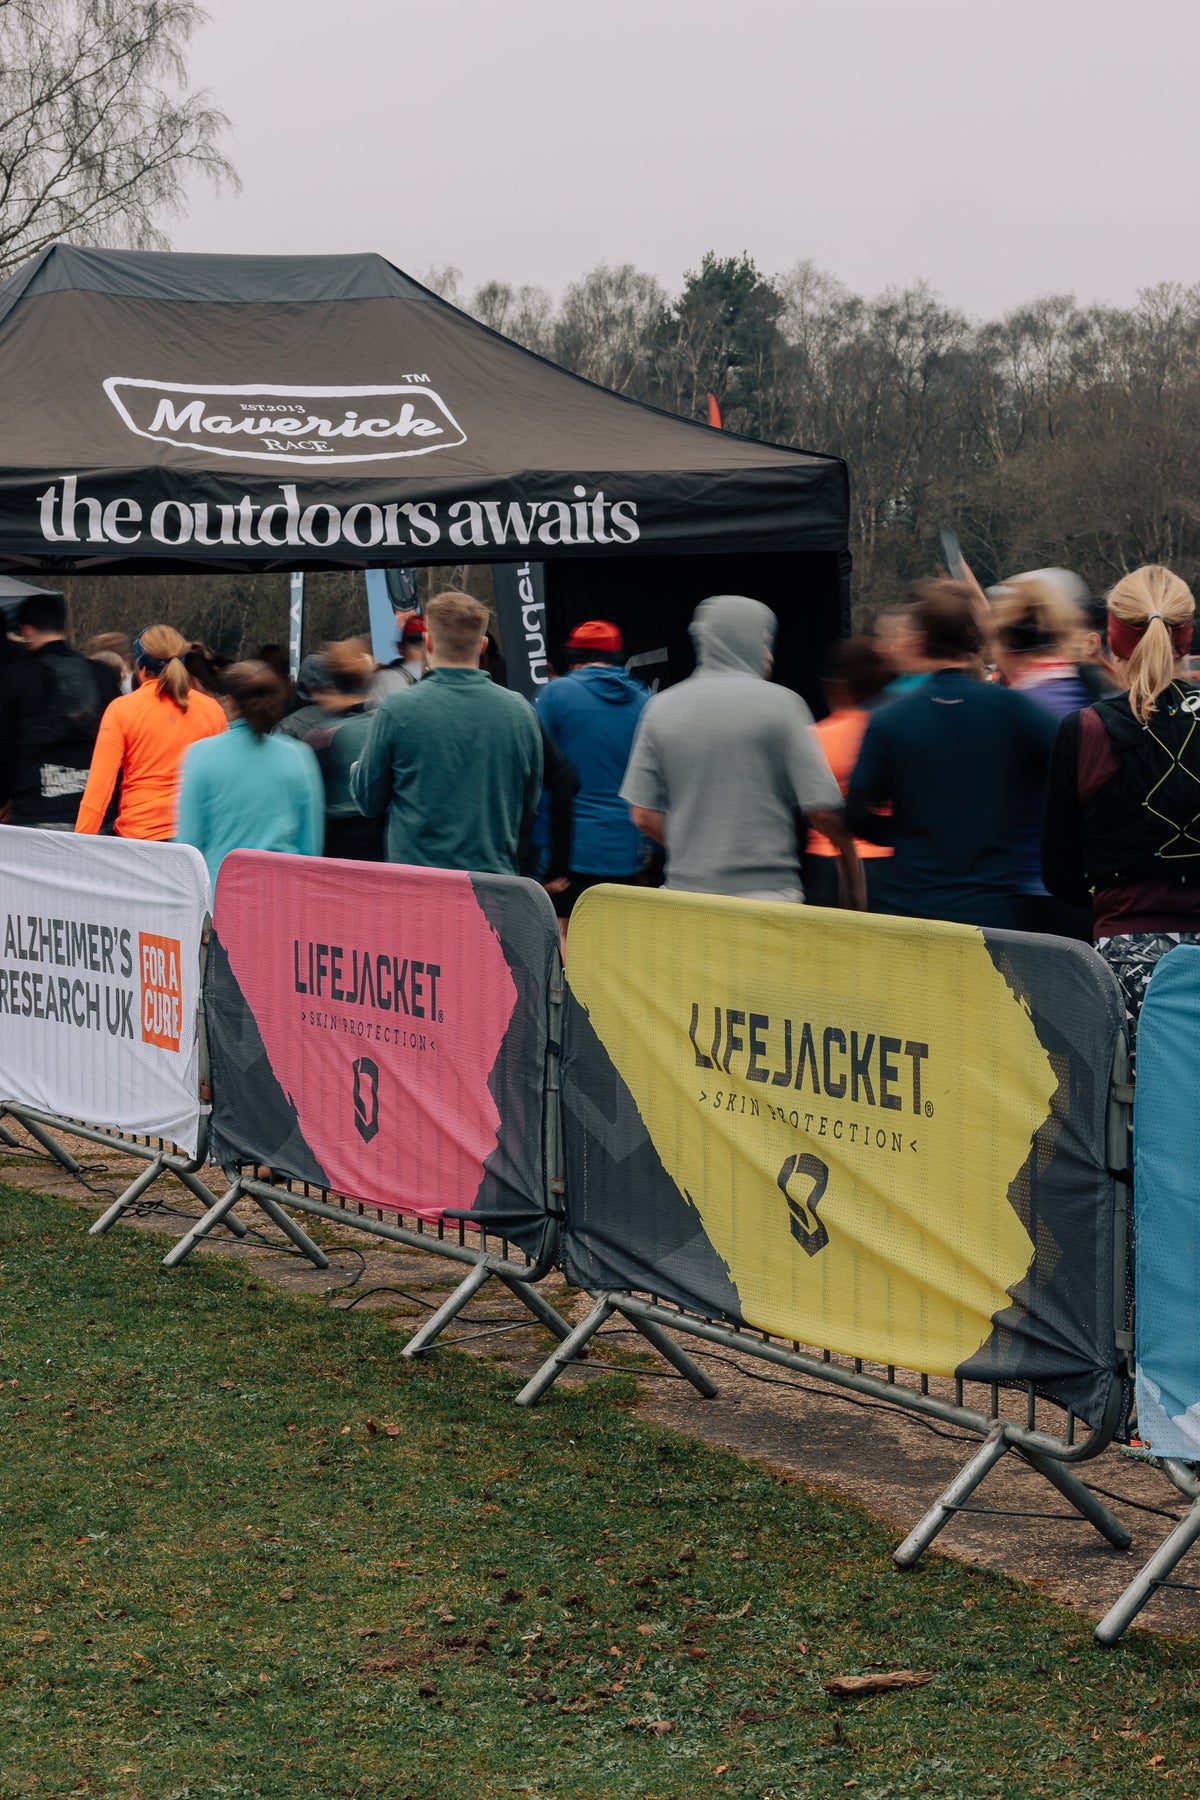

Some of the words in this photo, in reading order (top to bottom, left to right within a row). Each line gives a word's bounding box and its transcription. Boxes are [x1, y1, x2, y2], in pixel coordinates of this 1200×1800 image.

[148, 398, 444, 438] Maverick
[260, 438, 335, 452] RACE
[36, 475, 143, 544] the
[150, 484, 441, 547] outdoors
[448, 484, 641, 546] awaits
[4, 914, 133, 979] ALZHEIMER'S
[142, 945, 166, 988] FOR
[169, 952, 179, 992] A
[0, 968, 101, 1031] RESEARCH
[105, 985, 135, 1040] UK
[143, 989, 180, 1039] CURE
